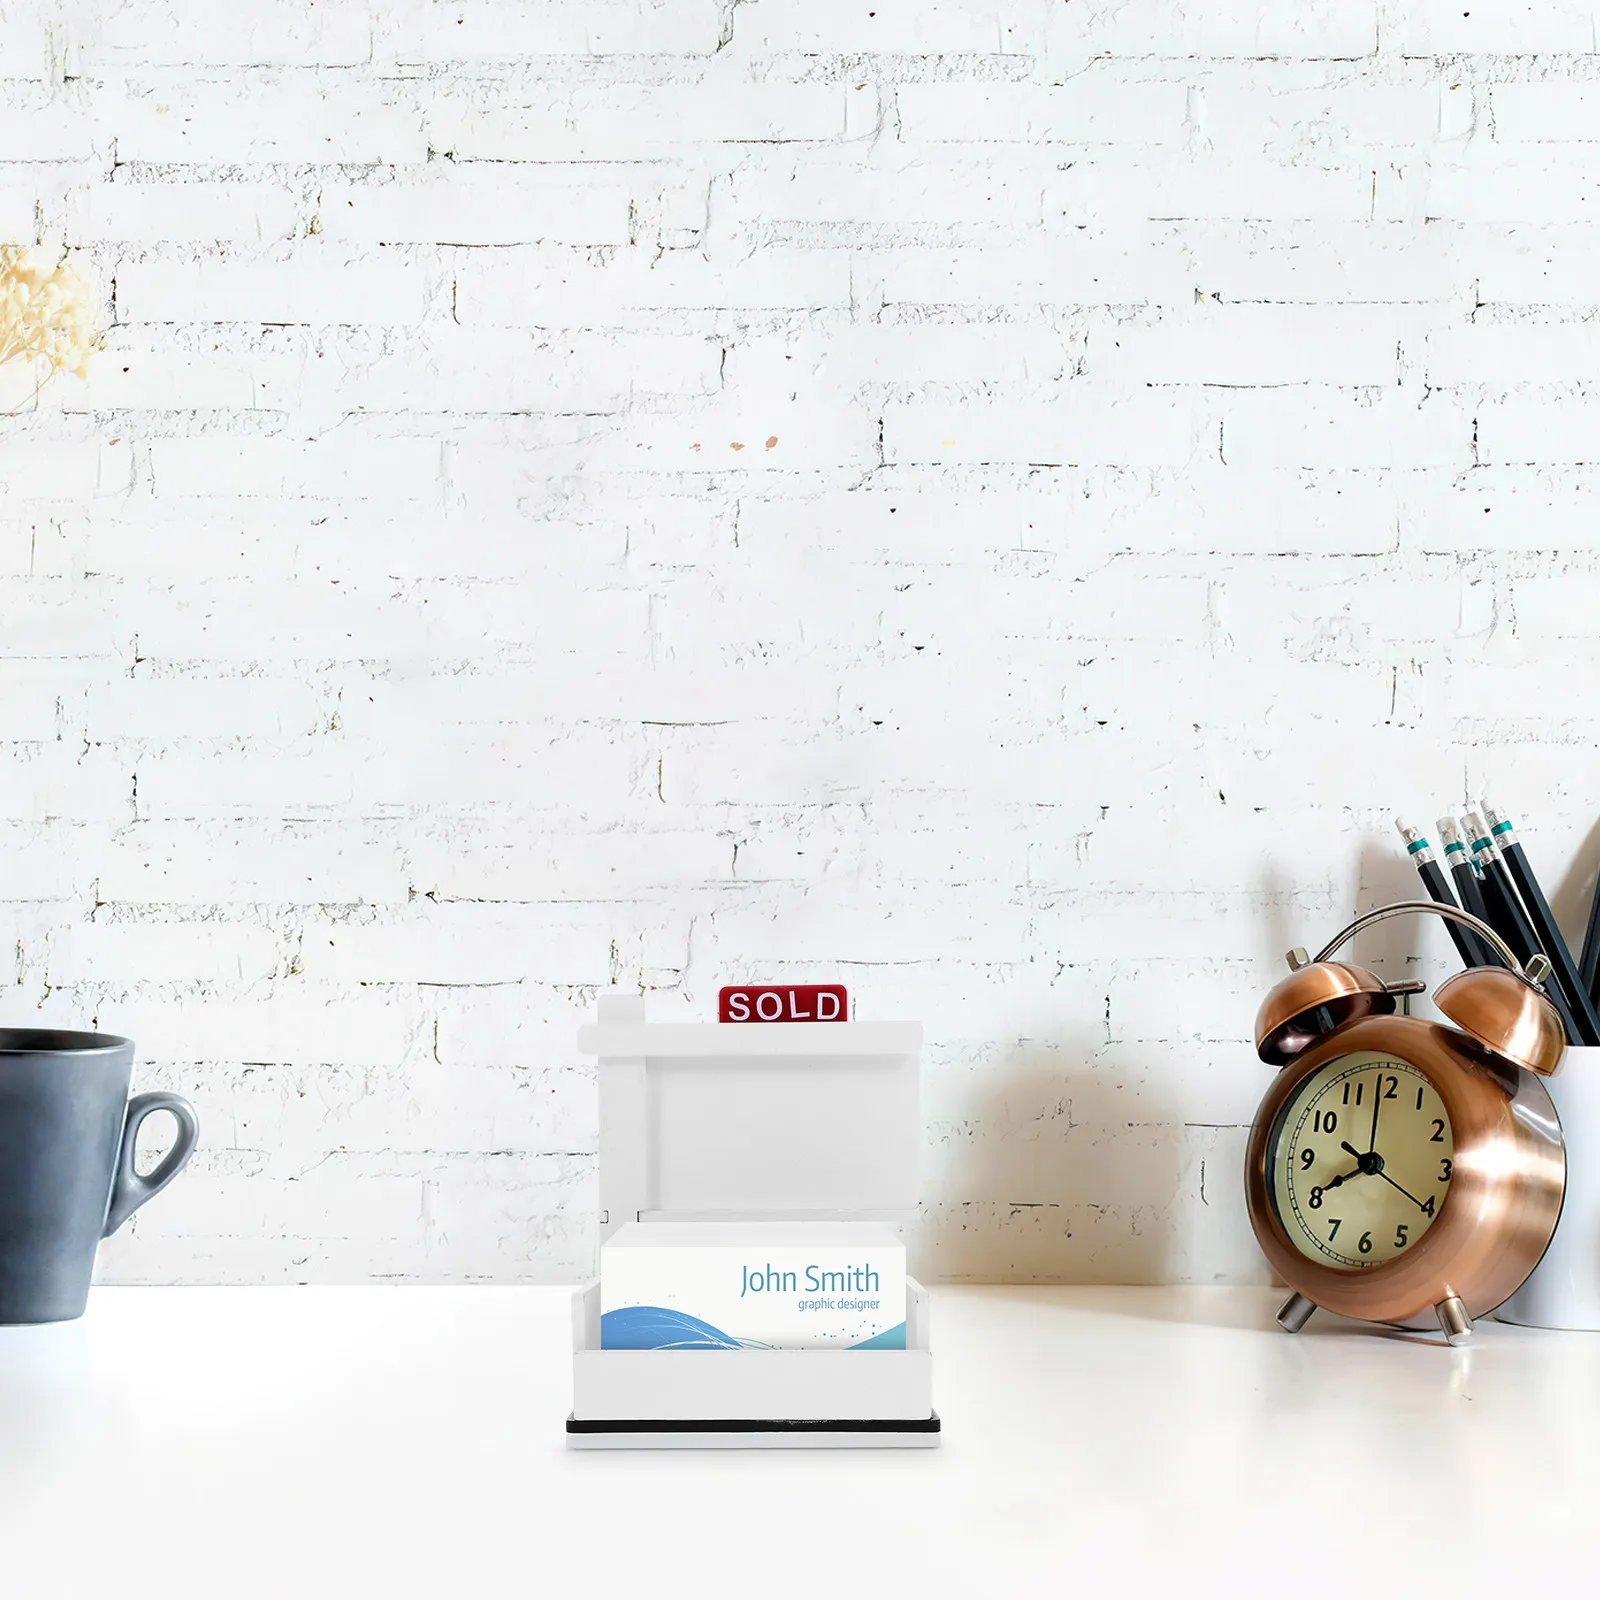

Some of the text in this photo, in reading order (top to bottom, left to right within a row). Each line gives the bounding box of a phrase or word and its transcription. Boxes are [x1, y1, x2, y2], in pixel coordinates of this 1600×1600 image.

[729, 990, 840, 1021] SOLD
[1342, 1082, 1363, 1106] 11
[1375, 1076, 1399, 1099] 2
[1416, 1087, 1424, 1110] 1
[1313, 1110, 1337, 1134] 10
[1430, 1119, 1446, 1142] 2
[1301, 1148, 1315, 1171] 9
[1438, 1159, 1453, 1182] 3
[1308, 1186, 1323, 1209] 8
[1421, 1195, 1436, 1218] 4
[1328, 1219, 1342, 1242] 7
[1394, 1225, 1409, 1248] 5
[1358, 1232, 1372, 1254] 6
[740, 1263, 880, 1298] John Smith
[798, 1298, 881, 1313] graphic designer
